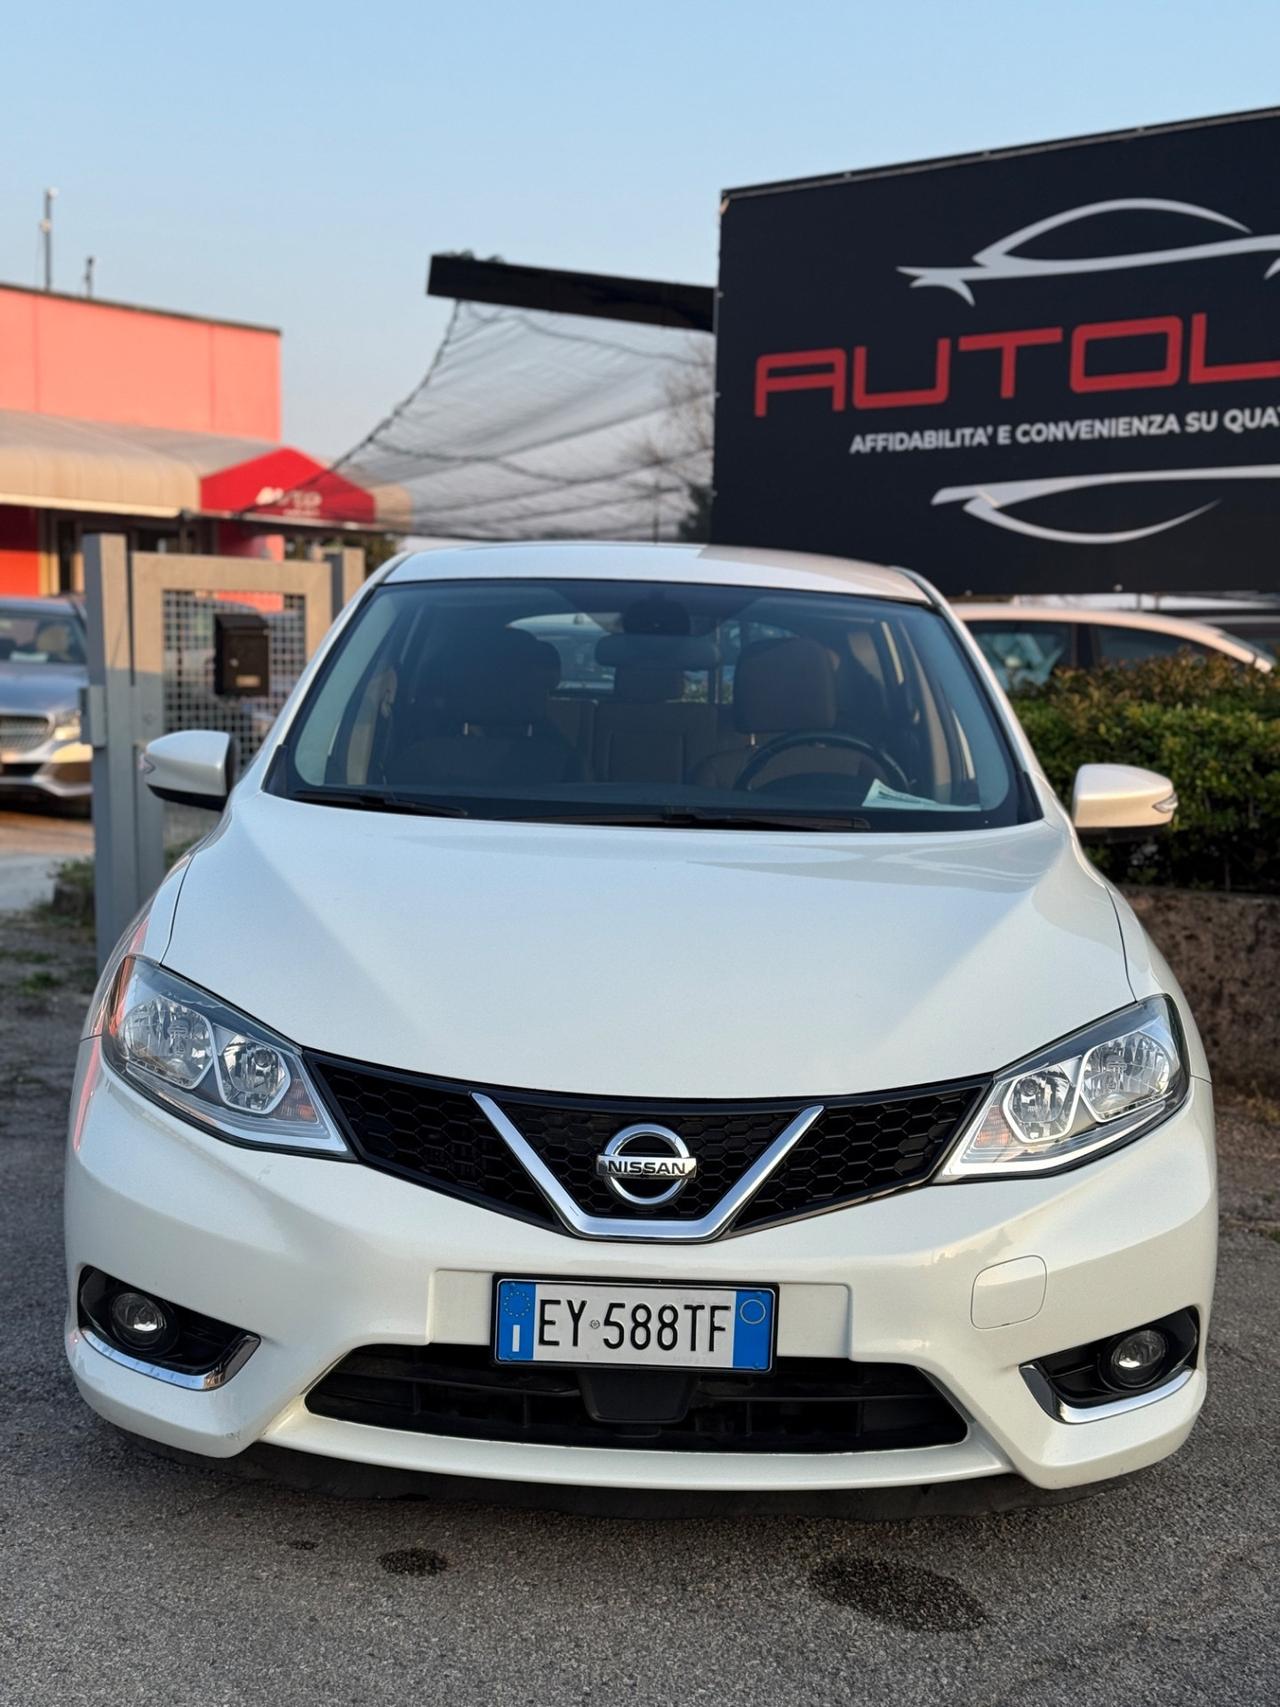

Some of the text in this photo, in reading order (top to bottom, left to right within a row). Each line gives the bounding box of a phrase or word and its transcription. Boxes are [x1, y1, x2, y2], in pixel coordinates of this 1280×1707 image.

[850, 406, 1280, 453] AFFIDABILITA' E CONVENIENZA SU QUA
[607, 1160, 685, 1175] NISSAN
[538, 1299, 732, 1352] EY 588TF
